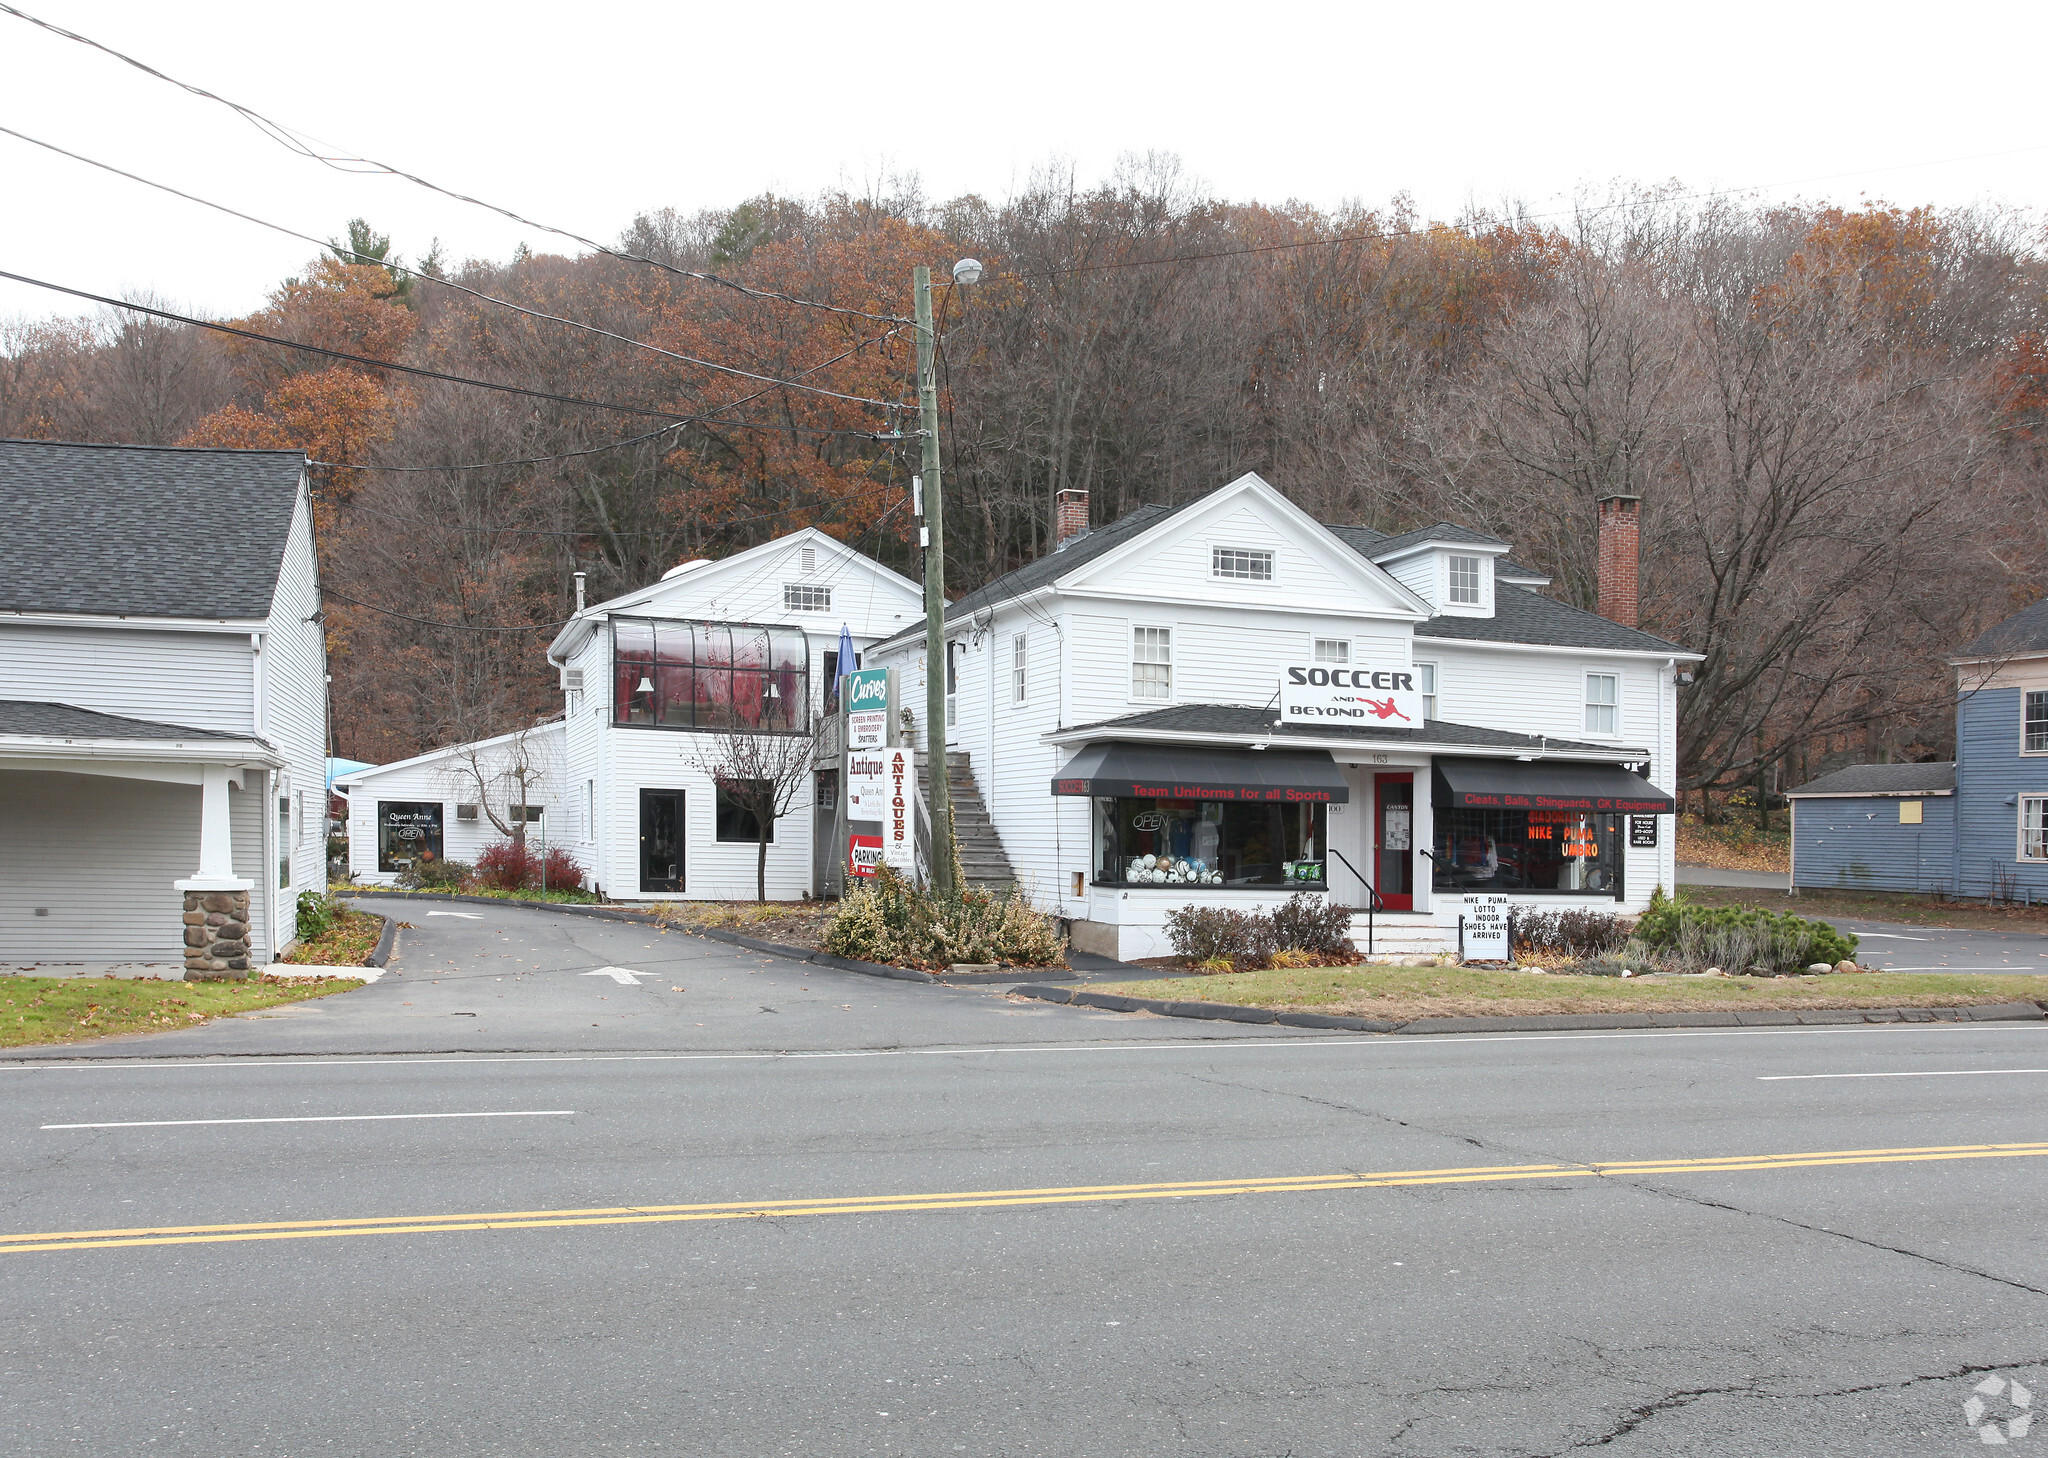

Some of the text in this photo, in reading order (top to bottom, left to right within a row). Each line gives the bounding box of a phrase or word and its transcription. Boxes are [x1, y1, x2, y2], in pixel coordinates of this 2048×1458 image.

[1288, 666, 1414, 691] SOCCER
[851, 675, 886, 703] Curves
[1290, 705, 1365, 718] BEYOND
[1372, 754, 1388, 764] 163
[892, 752, 905, 841] ANTIQUES
[1131, 784, 1330, 802] Team Uniforms for all Sports
[1464, 793, 1667, 811] Cleats, Balls, Shinguards, GK Equipment
[390, 812, 432, 821] Queen Anne
[1132, 815, 1169, 828] OPEN
[1528, 826, 1594, 841] NIKE PUMA
[1561, 842, 1598, 857] UMBRO
[854, 849, 883, 864] PARKING
[1463, 896, 1508, 904] NIKE PUMA
[1474, 905, 1496, 913] LOTTO
[1475, 914, 1500, 922] INDOOR
[1464, 922, 1486, 930] SHOES
[1472, 931, 1501, 939] ARRIVED
